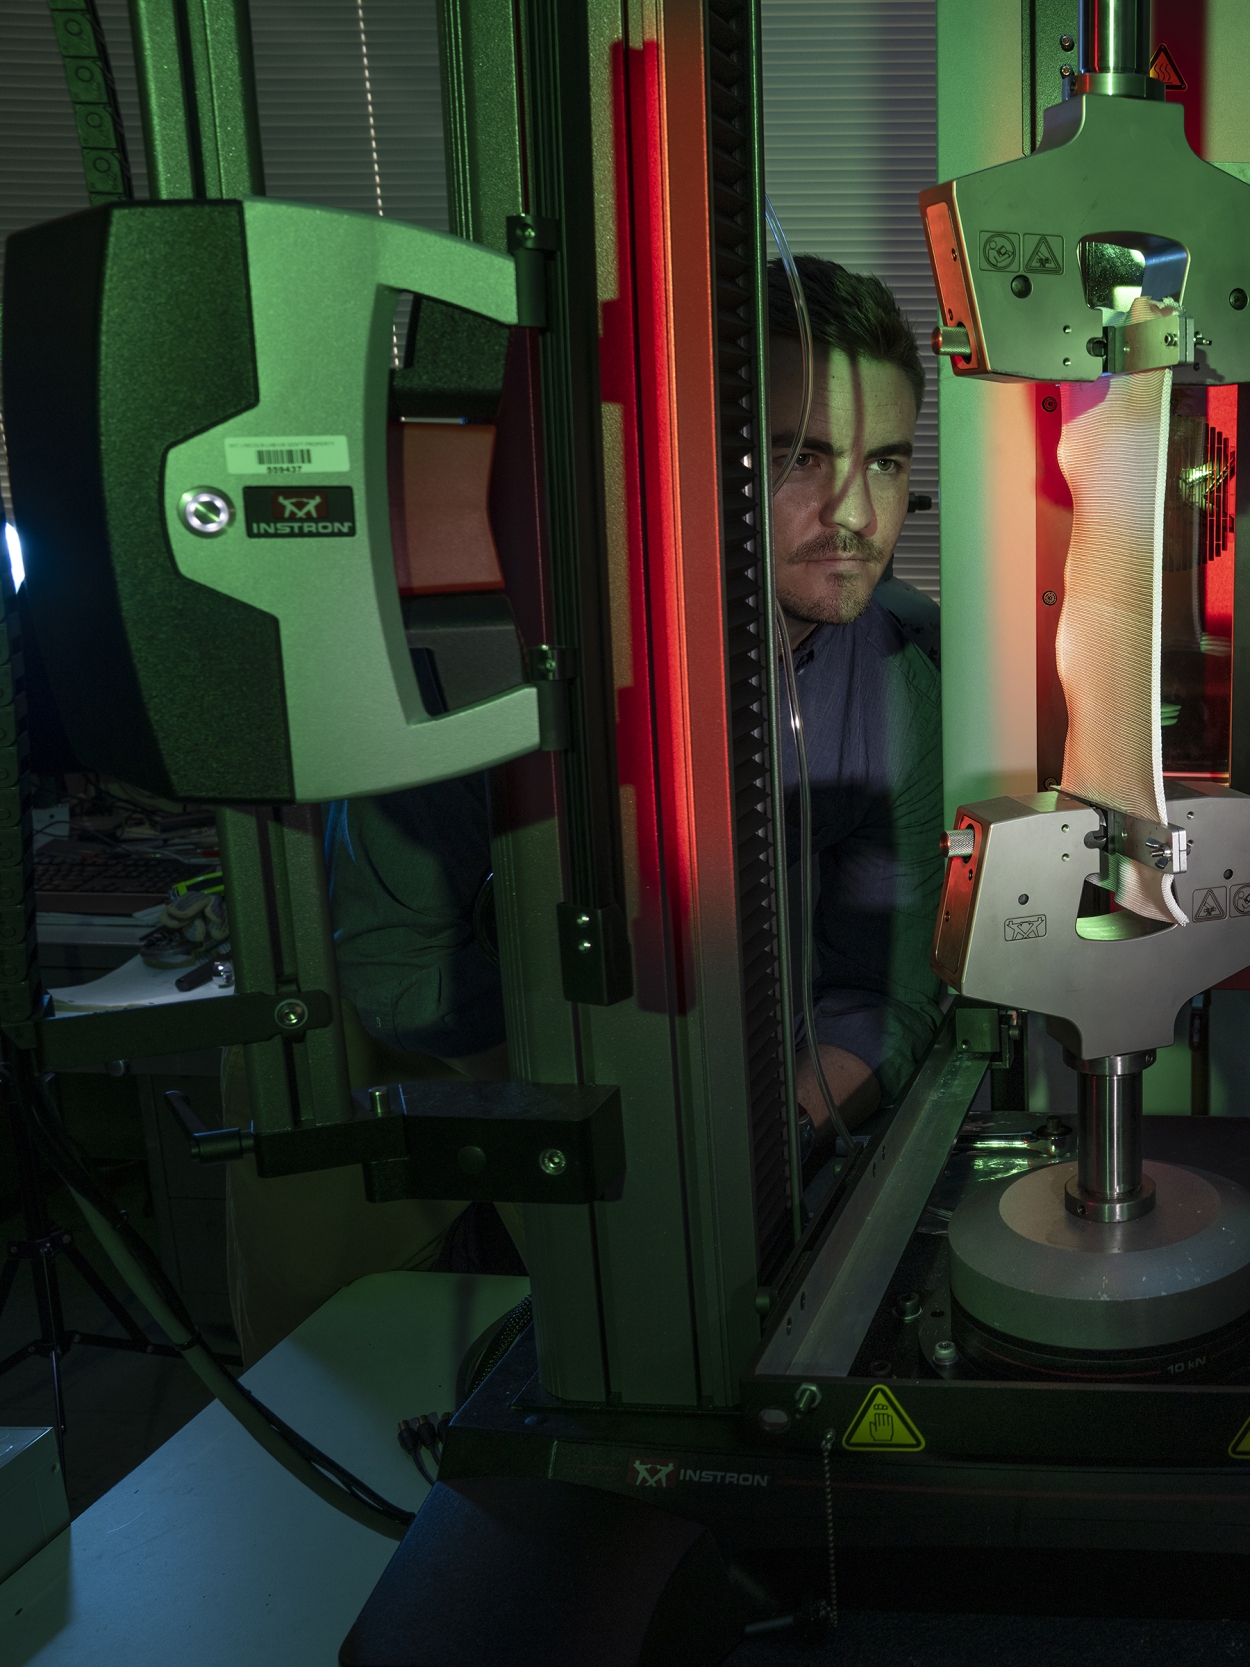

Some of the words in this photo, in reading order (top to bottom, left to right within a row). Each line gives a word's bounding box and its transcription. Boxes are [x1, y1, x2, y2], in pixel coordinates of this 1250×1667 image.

[252, 522, 350, 534] INSTRON
[1167, 1362, 1185, 1374] 10
[1188, 1355, 1207, 1370] kN
[679, 1468, 769, 1487] INSTRON
